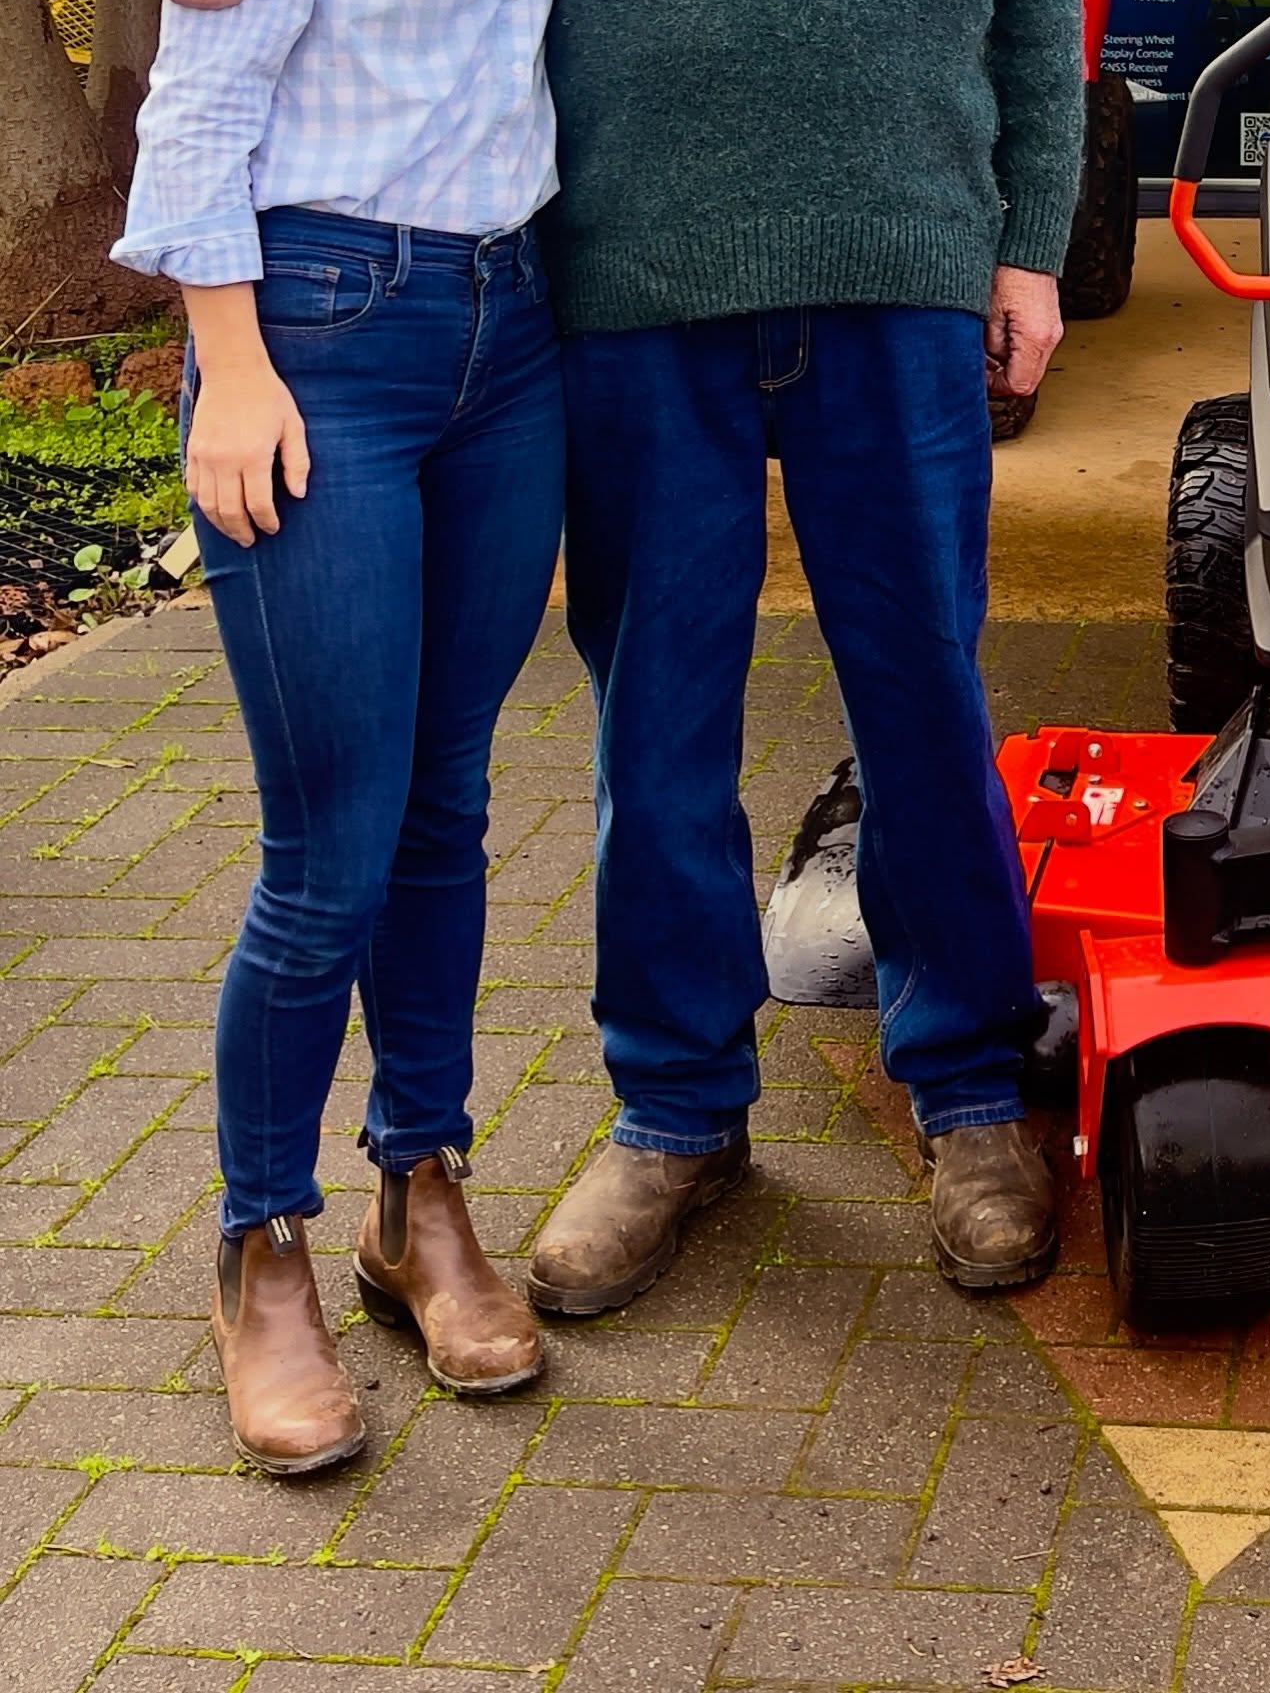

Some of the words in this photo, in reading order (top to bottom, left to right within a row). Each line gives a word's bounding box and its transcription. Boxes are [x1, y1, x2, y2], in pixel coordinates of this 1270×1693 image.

[1104, 34, 1143, 46] Steering
[1145, 35, 1175, 45] Wheel
[1100, 48, 1134, 60] Display
[1136, 48, 1174, 58] Console
[1129, 62, 1168, 73] Receiver
